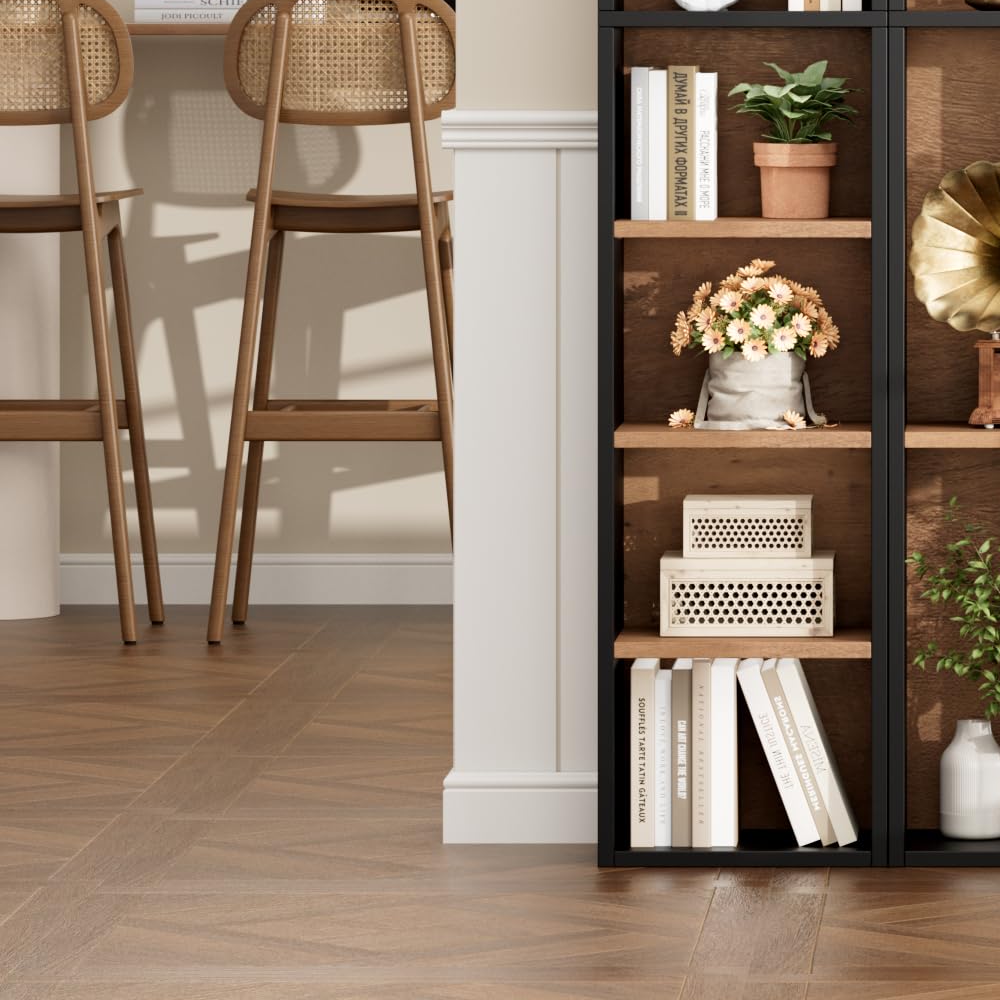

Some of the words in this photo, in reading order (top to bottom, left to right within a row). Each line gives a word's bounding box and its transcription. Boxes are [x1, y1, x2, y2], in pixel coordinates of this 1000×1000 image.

[673, 71, 690, 105] ДУМАЙ
[673, 117, 688, 153] ДРУГИХ
[674, 157, 688, 207] ФОРМАТАХ
[699, 168, 710, 182] МНЕ
[699, 191, 710, 209] МОРЕ
[638, 697, 646, 735] SOUFFLÉS
[638, 737, 646, 761] TARTE
[638, 763, 646, 785] TATIN
[638, 787, 647, 823] GÂTEAUX
